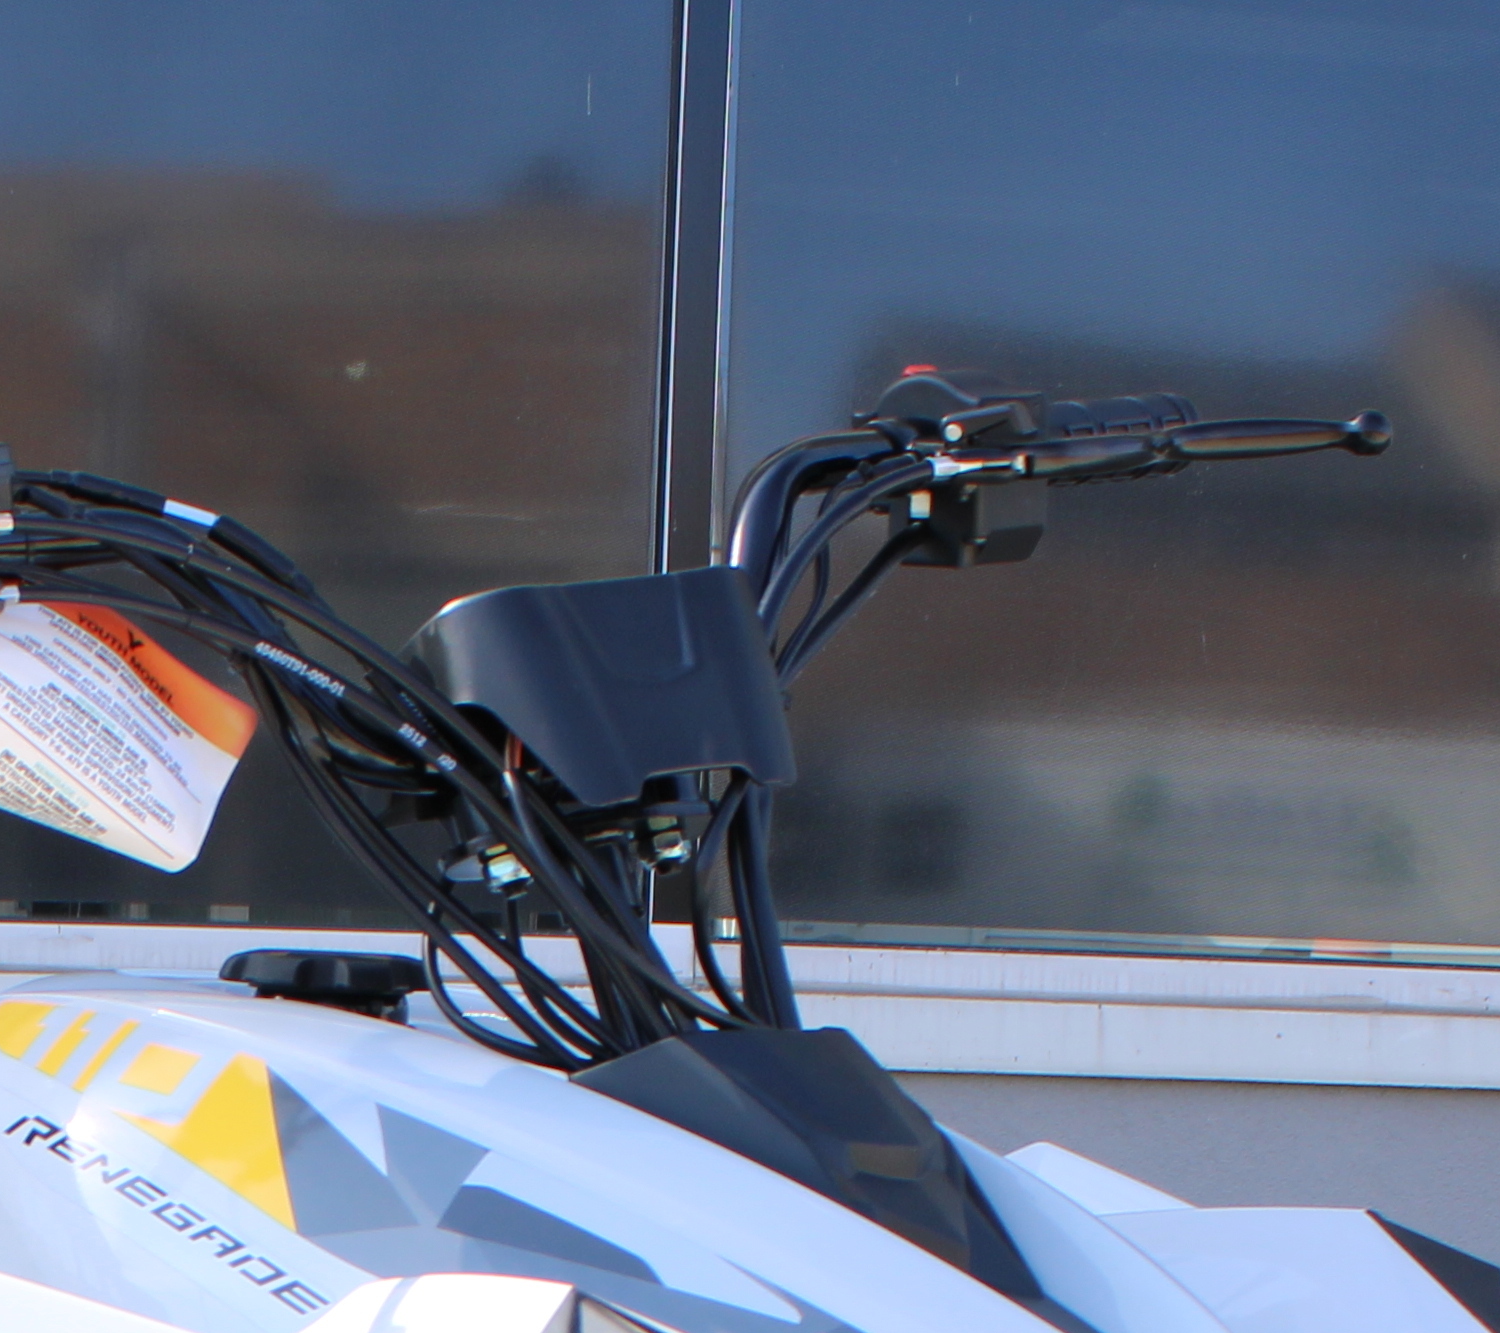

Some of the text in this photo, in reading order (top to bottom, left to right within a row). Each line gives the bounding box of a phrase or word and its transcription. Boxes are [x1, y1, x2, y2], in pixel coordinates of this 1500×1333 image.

[75, 611, 175, 705] YOUTH MODEL
[3, 1114, 332, 1316] RENEGADE
